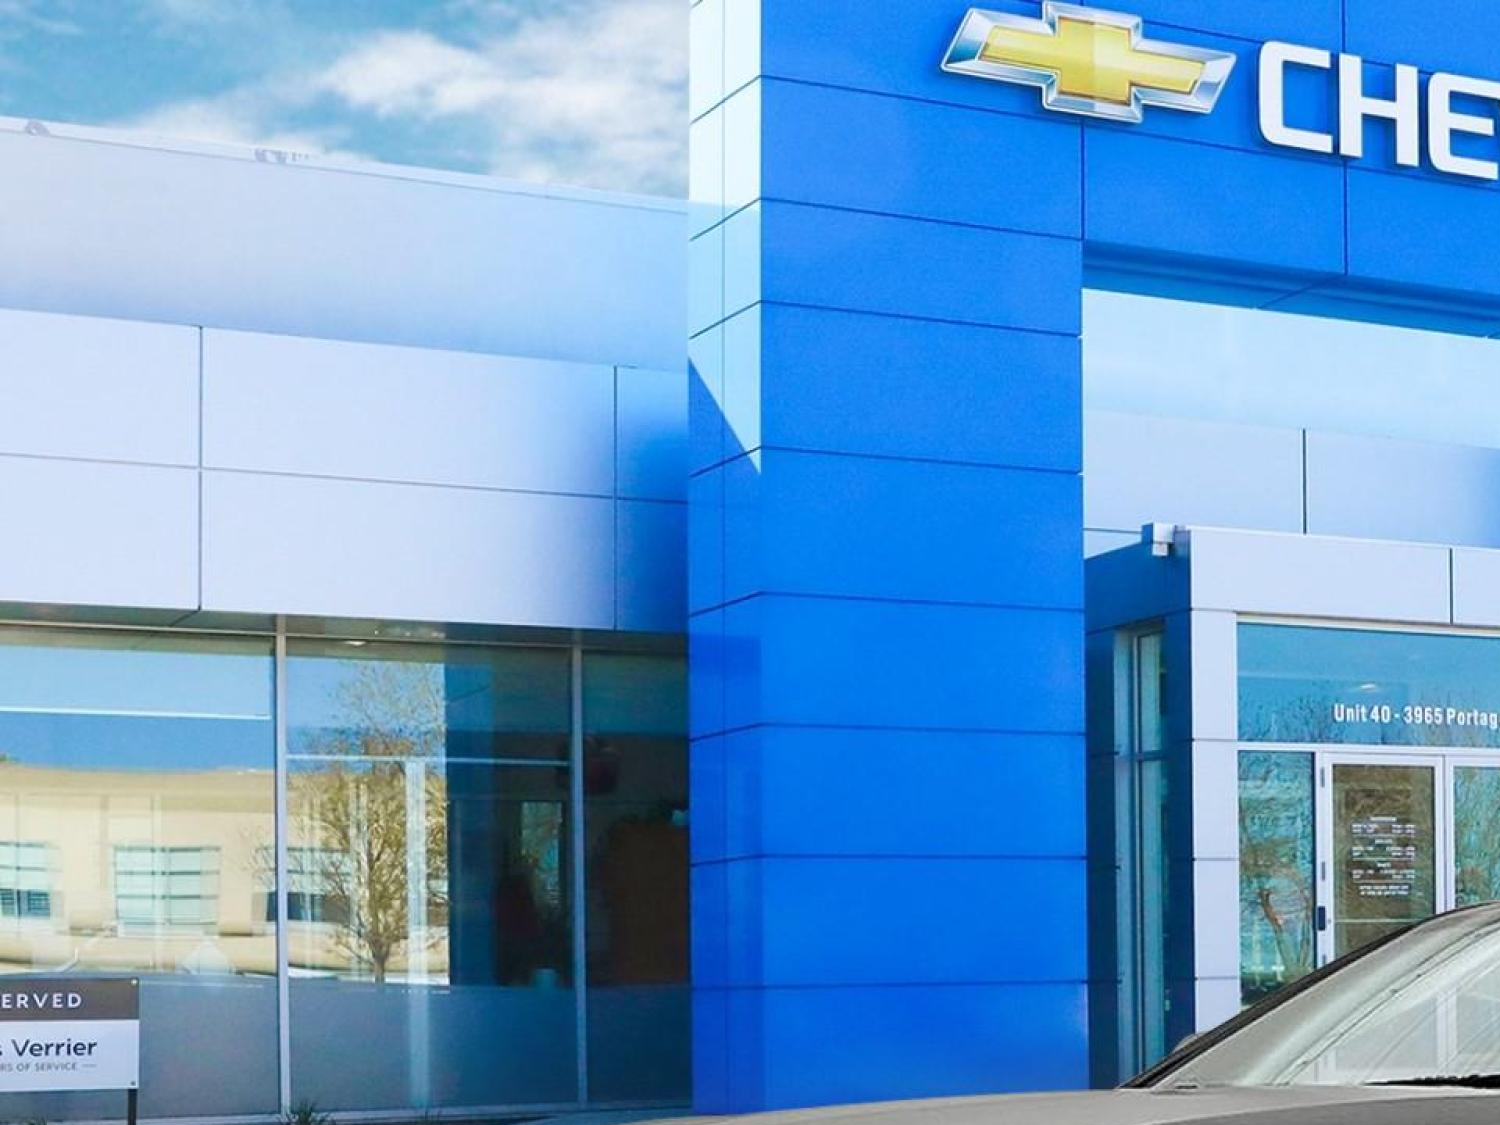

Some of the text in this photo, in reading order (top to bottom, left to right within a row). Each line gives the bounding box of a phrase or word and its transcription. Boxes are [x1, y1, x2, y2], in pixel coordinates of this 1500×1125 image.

[1333, 703, 1367, 723] Unit
[1370, 704, 1391, 724] 40
[1403, 705, 1444, 725] 3965
[2, 992, 82, 1009] ERVED
[11, 1038, 98, 1057] Verrier
[16, 1062, 31, 1073] OF
[35, 1062, 78, 1072] SERVICE
